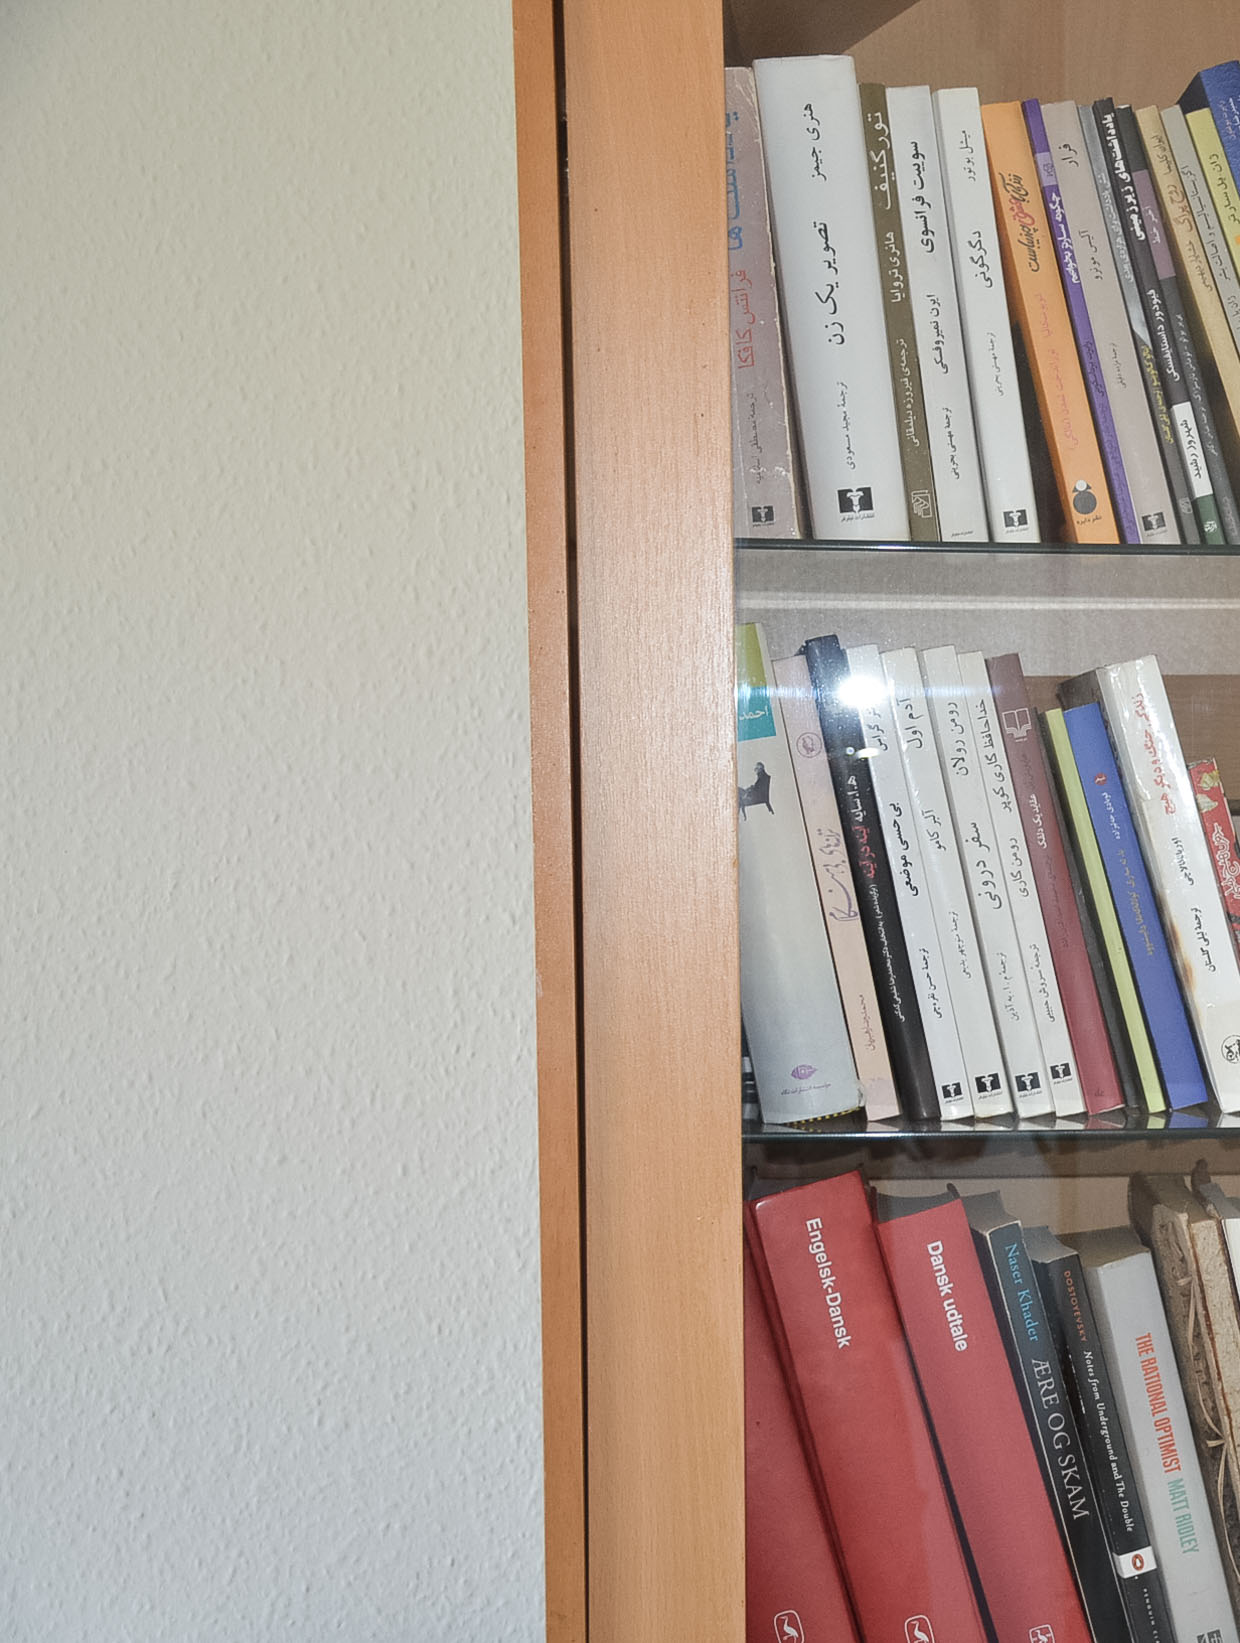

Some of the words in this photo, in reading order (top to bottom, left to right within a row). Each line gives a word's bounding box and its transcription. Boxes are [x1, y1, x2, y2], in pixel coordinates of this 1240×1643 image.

[803, 103, 821, 141] هنری
[960, 130, 974, 153] میشل
[1058, 143, 1079, 167] فرار
[811, 147, 827, 181] جیمز
[1168, 184, 1187, 205] روح
[911, 195, 935, 253] فرانسوی
[1173, 205, 1193, 232] پراگ
[813, 221, 839, 275] تصویر
[884, 231, 900, 268] هانری
[967, 230, 993, 289] دگرگونی
[1078, 229, 1098, 253] آلیس
[1089, 256, 1103, 281] مونرو
[730, 269, 756, 323] فرانتس
[815, 282, 839, 315] یک
[888, 269, 906, 304] تروایا
[926, 294, 941, 317] ایرن
[1146, 288, 1164, 325] فیودور
[735, 329, 755, 369] کافکا
[824, 321, 845, 345] زن
[930, 320, 949, 375] نمیروفسکی
[842, 433, 856, 469] مسعودی
[1179, 419, 1197, 452] شهروز
[1190, 453, 1202, 479] رشید
[897, 698, 925, 720] آدم
[948, 702, 965, 735] رومن
[975, 699, 995, 749] خداحافظ
[866, 717, 888, 751] گراس
[904, 726, 923, 749] اول
[950, 739, 969, 776] رولان
[985, 753, 1006, 783] گاری
[992, 787, 1013, 813] کوپر
[852, 825, 870, 845] آینه
[921, 809, 942, 827] آلبر
[858, 845, 876, 858] در
[926, 829, 947, 852] کامو
[964, 821, 991, 852] سفر
[1008, 837, 1023, 868] رومن
[1035, 826, 1048, 849] دلقک
[859, 859, 877, 879] آینه
[899, 855, 919, 896] موضعی
[975, 860, 1002, 910] درونی
[1010, 868, 1030, 897] گاری
[805, 1217, 852, 1349] Engelsk-Dansk
[927, 1240, 954, 1297] Dansk
[943, 1298, 968, 1352] udtale
[1005, 1243, 1024, 1285] Naser
[1018, 1288, 1040, 1342] Khader
[1063, 1270, 1088, 1342] DOSTOYEVSKY
[1136, 1332, 1155, 1357] THE
[1083, 1350, 1095, 1377] Notes
[1031, 1358, 1060, 1409] ÆRE
[1087, 1377, 1101, 1400] from
[1140, 1357, 1169, 1417] RATIONAL
[1049, 1412, 1071, 1450] OG
[1096, 1403, 1117, 1461] Underground
[1154, 1417, 1182, 1474] OPTIMIST
[1057, 1454, 1090, 1521] SKAM
[1110, 1461, 1123, 1481] and
[1115, 1480, 1125, 1498] The
[1167, 1478, 1190, 1518] MATT
[1120, 1500, 1136, 1533] Double
[1175, 1517, 1200, 1555] RIDLEY
